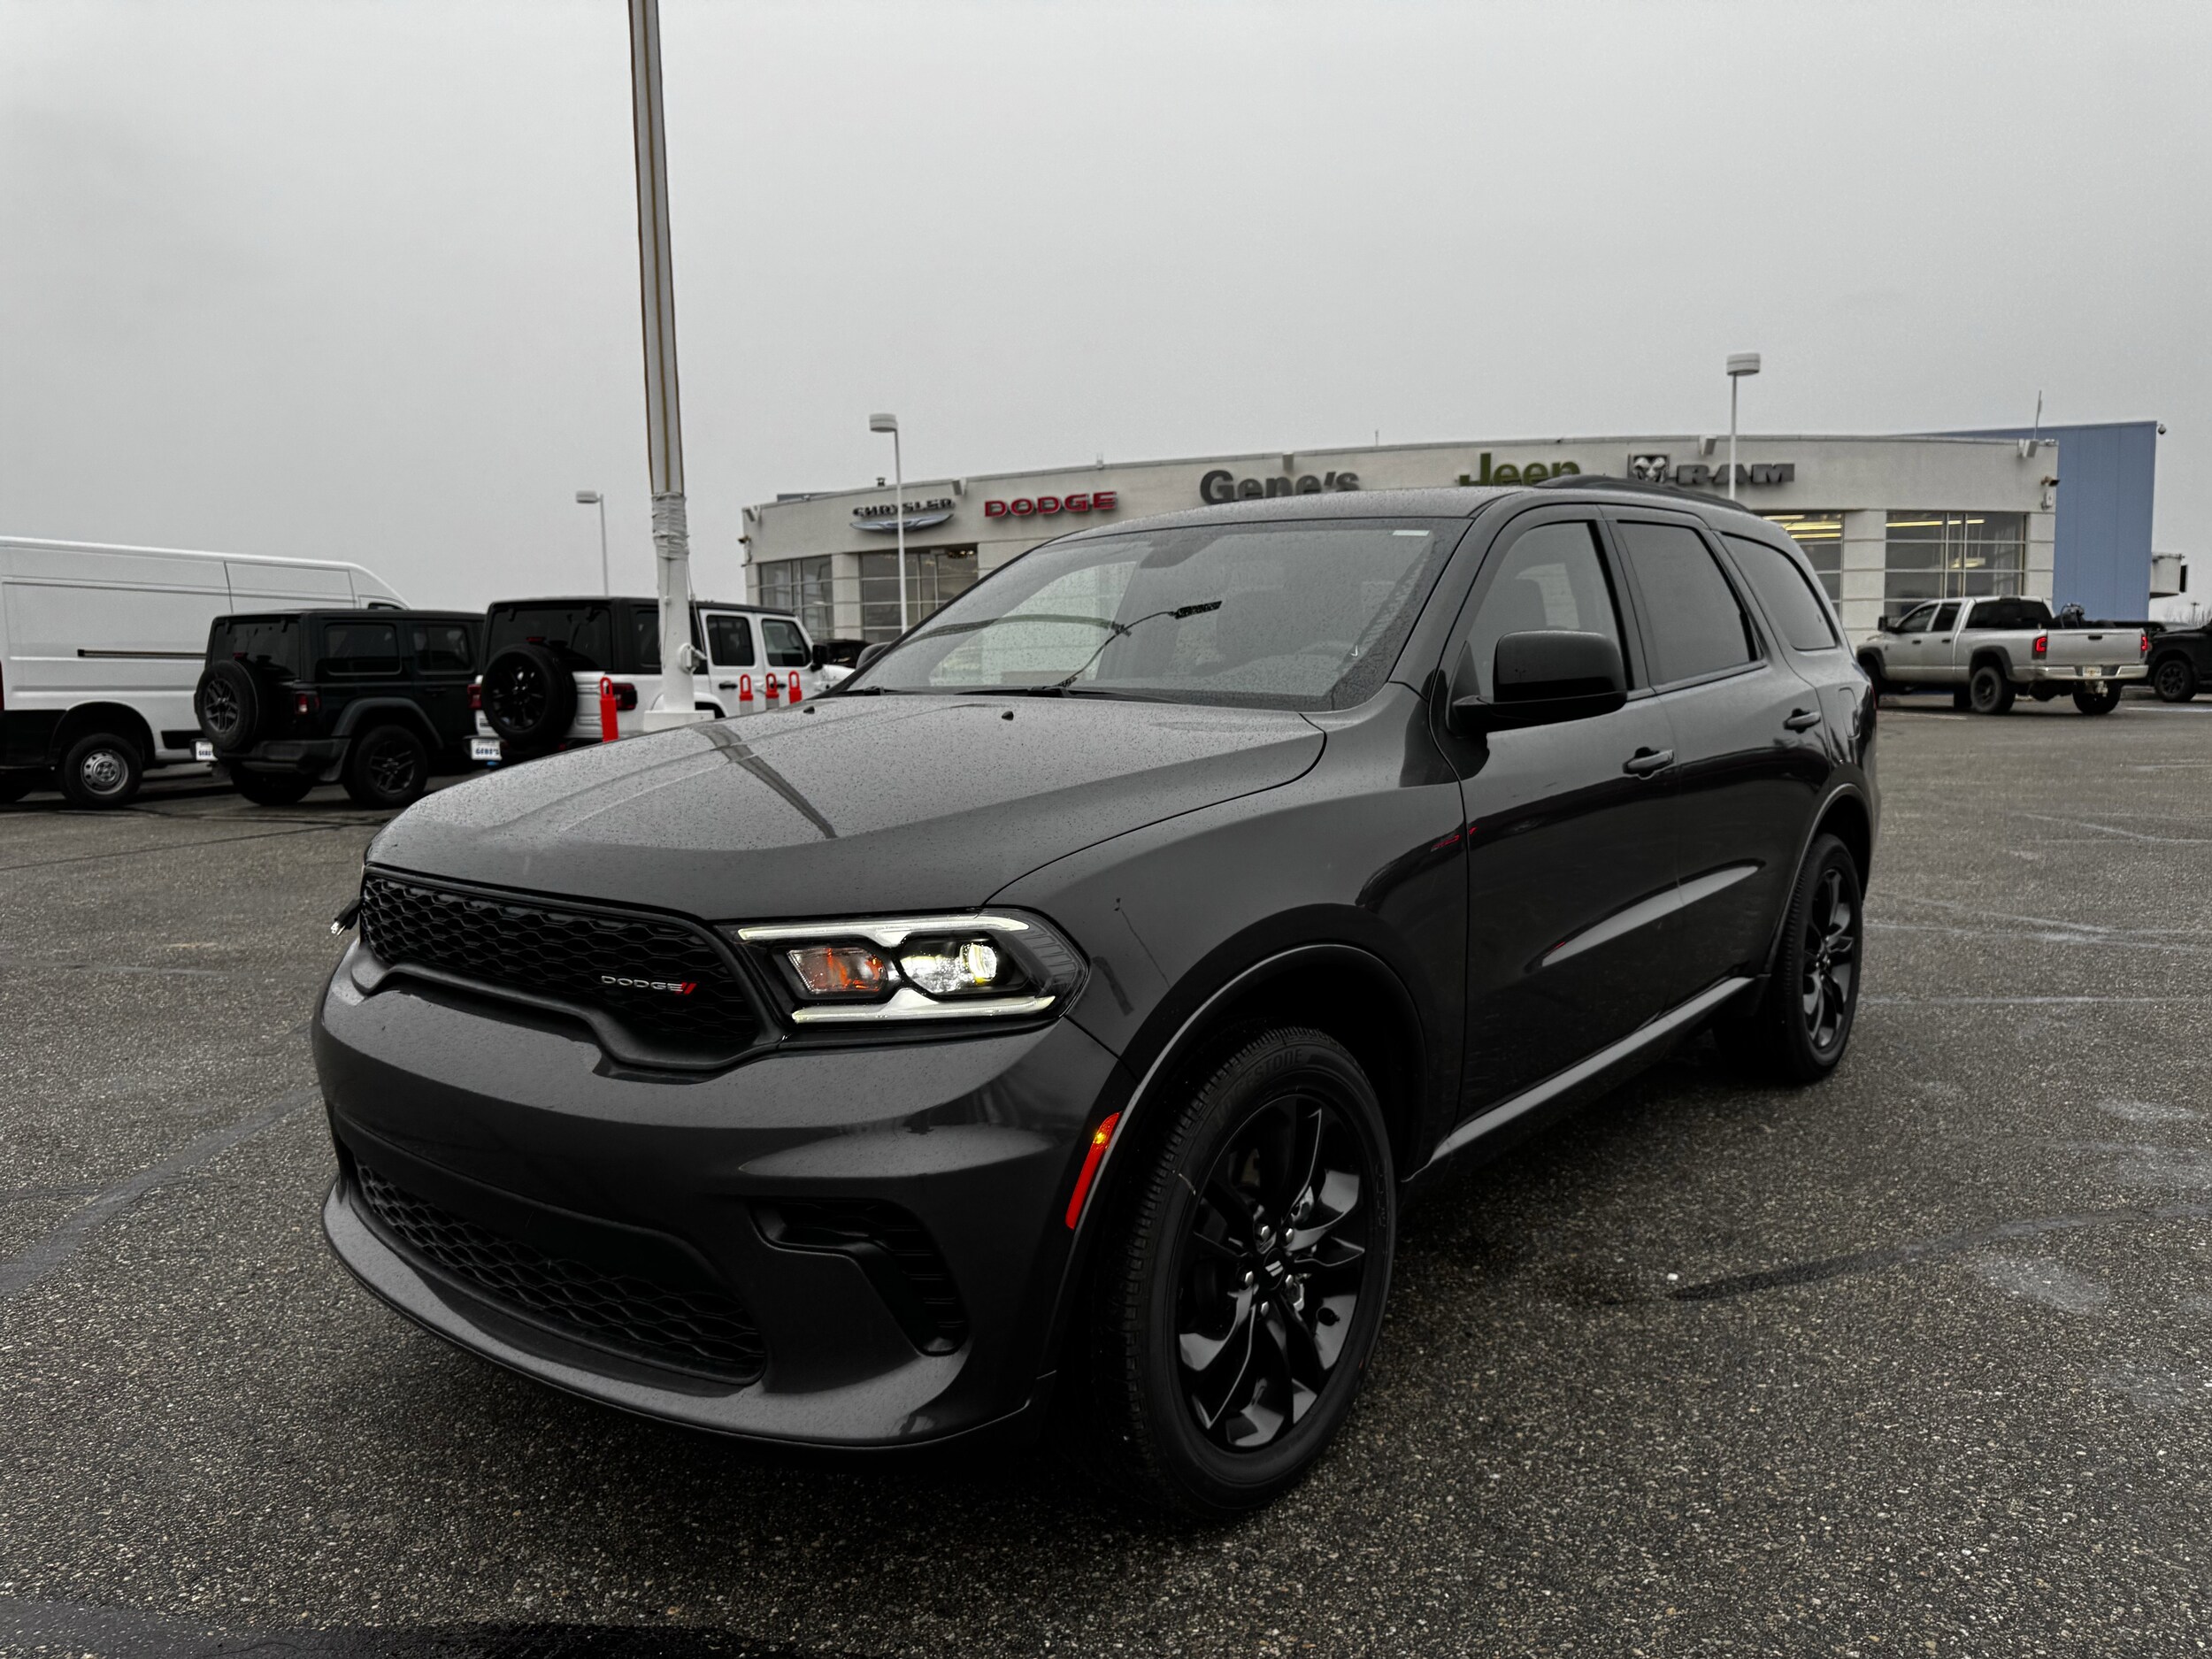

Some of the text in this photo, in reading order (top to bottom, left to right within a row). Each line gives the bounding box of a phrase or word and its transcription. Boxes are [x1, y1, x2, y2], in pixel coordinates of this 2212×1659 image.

[1677, 463, 1794, 484] RAM
[1200, 470, 1360, 505] Gene's
[853, 497, 956, 518] CHRYSLER
[985, 491, 1117, 518] DODGE
[601, 975, 684, 992] DODGE
[1207, 1048, 1302, 1136] IDGESTONE
